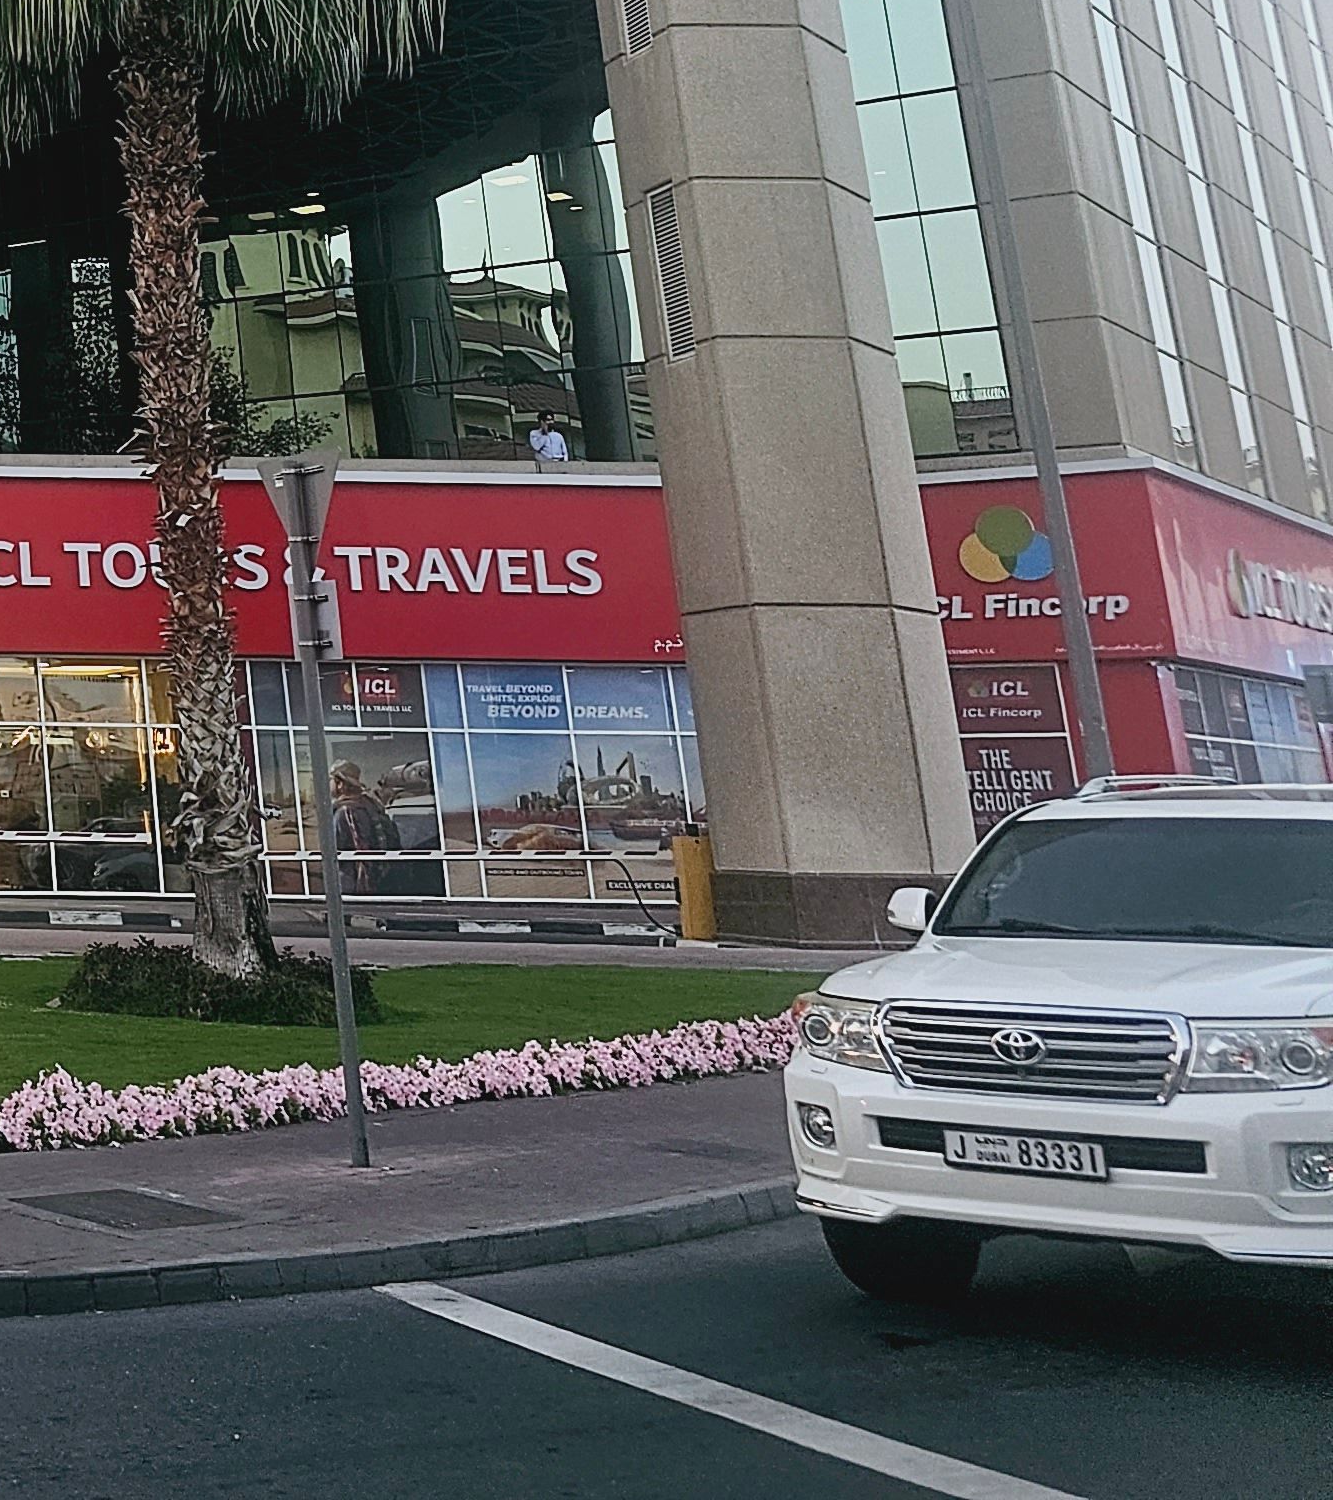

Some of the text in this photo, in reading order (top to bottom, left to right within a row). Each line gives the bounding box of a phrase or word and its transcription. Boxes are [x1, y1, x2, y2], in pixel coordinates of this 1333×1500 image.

[62, 542, 270, 590] TOUS
[333, 546, 603, 596] TRAVELS
[935, 593, 1130, 621] CL Fincrp
[363, 678, 397, 694] ICL
[466, 684, 554, 694] TRAVEL BEYOND
[991, 681, 1029, 696] ICL
[518, 694, 563, 704] EXPLORE
[487, 704, 650, 720] BEYOND DREAMS.
[962, 707, 1042, 719] ICL Fincorp
[978, 749, 1013, 769] THE
[973, 792, 1032, 812] CHOICE
[953, 1134, 966, 1160] J
[1017, 1139, 1098, 1174] 83331
